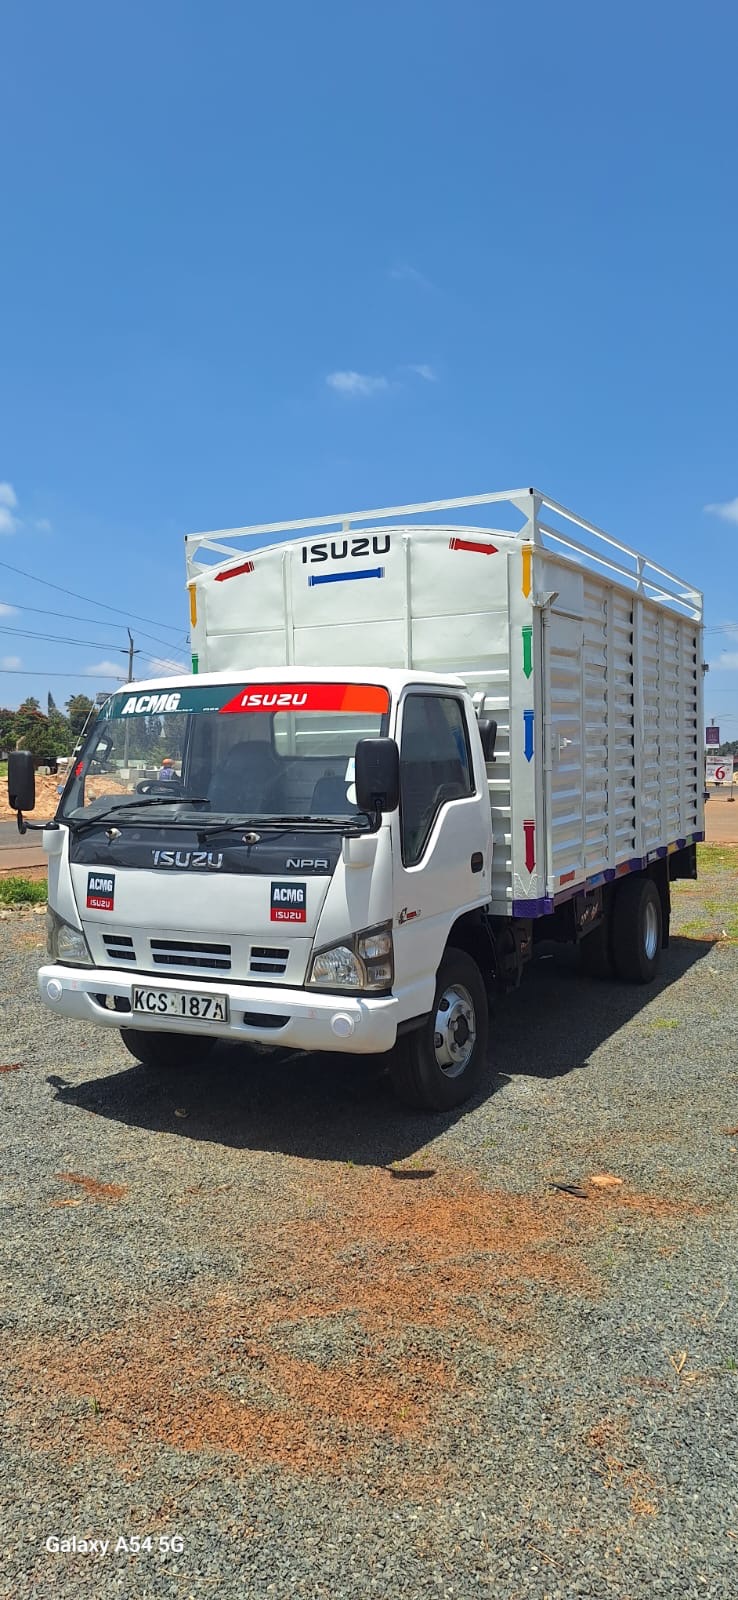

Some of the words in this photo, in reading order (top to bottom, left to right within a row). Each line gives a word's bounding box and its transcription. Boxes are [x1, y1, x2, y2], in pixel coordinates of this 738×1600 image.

[302, 535, 390, 564] ISUZU
[121, 693, 182, 714] ACMG
[241, 693, 308, 706] ISUZU
[715, 765, 726, 780] 6
[152, 850, 224, 869] ISUZU
[286, 859, 329, 869] NPR
[89, 878, 113, 892] ACMG
[273, 888, 304, 902] ACMG
[90, 899, 111, 908] ISUZU
[275, 911, 302, 920] ISUZU
[134, 990, 168, 1013] KCS
[181, 995, 224, 1020] 187A
